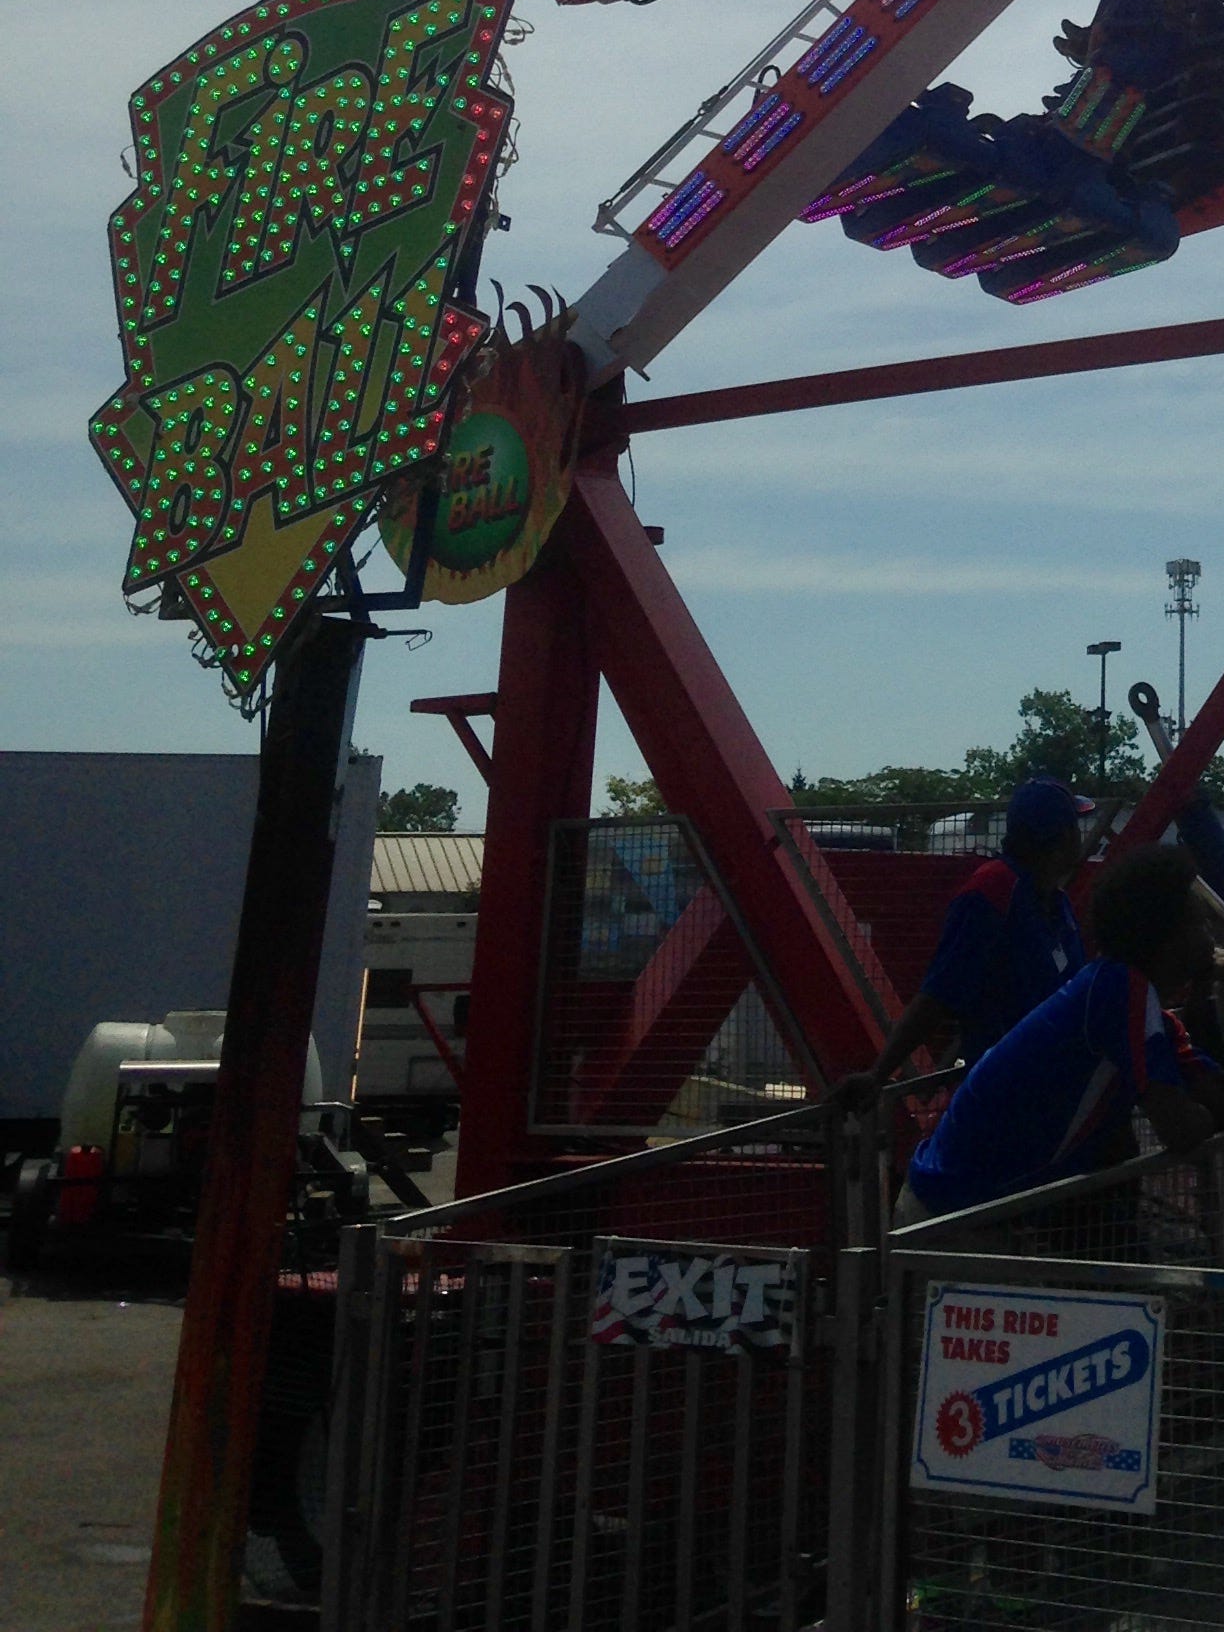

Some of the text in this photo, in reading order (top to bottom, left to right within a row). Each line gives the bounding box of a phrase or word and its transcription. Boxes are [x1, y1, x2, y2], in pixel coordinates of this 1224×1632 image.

[122, 230, 462, 592] BALL
[448, 474, 521, 536] BALL
[609, 1255, 782, 1324] EXIT
[648, 1325, 732, 1349] SALIDA
[941, 1336, 1010, 1365] TAKES
[943, 1305, 1059, 1337] THIS RIDE
[948, 1340, 1133, 1447] 3 TICKETS
